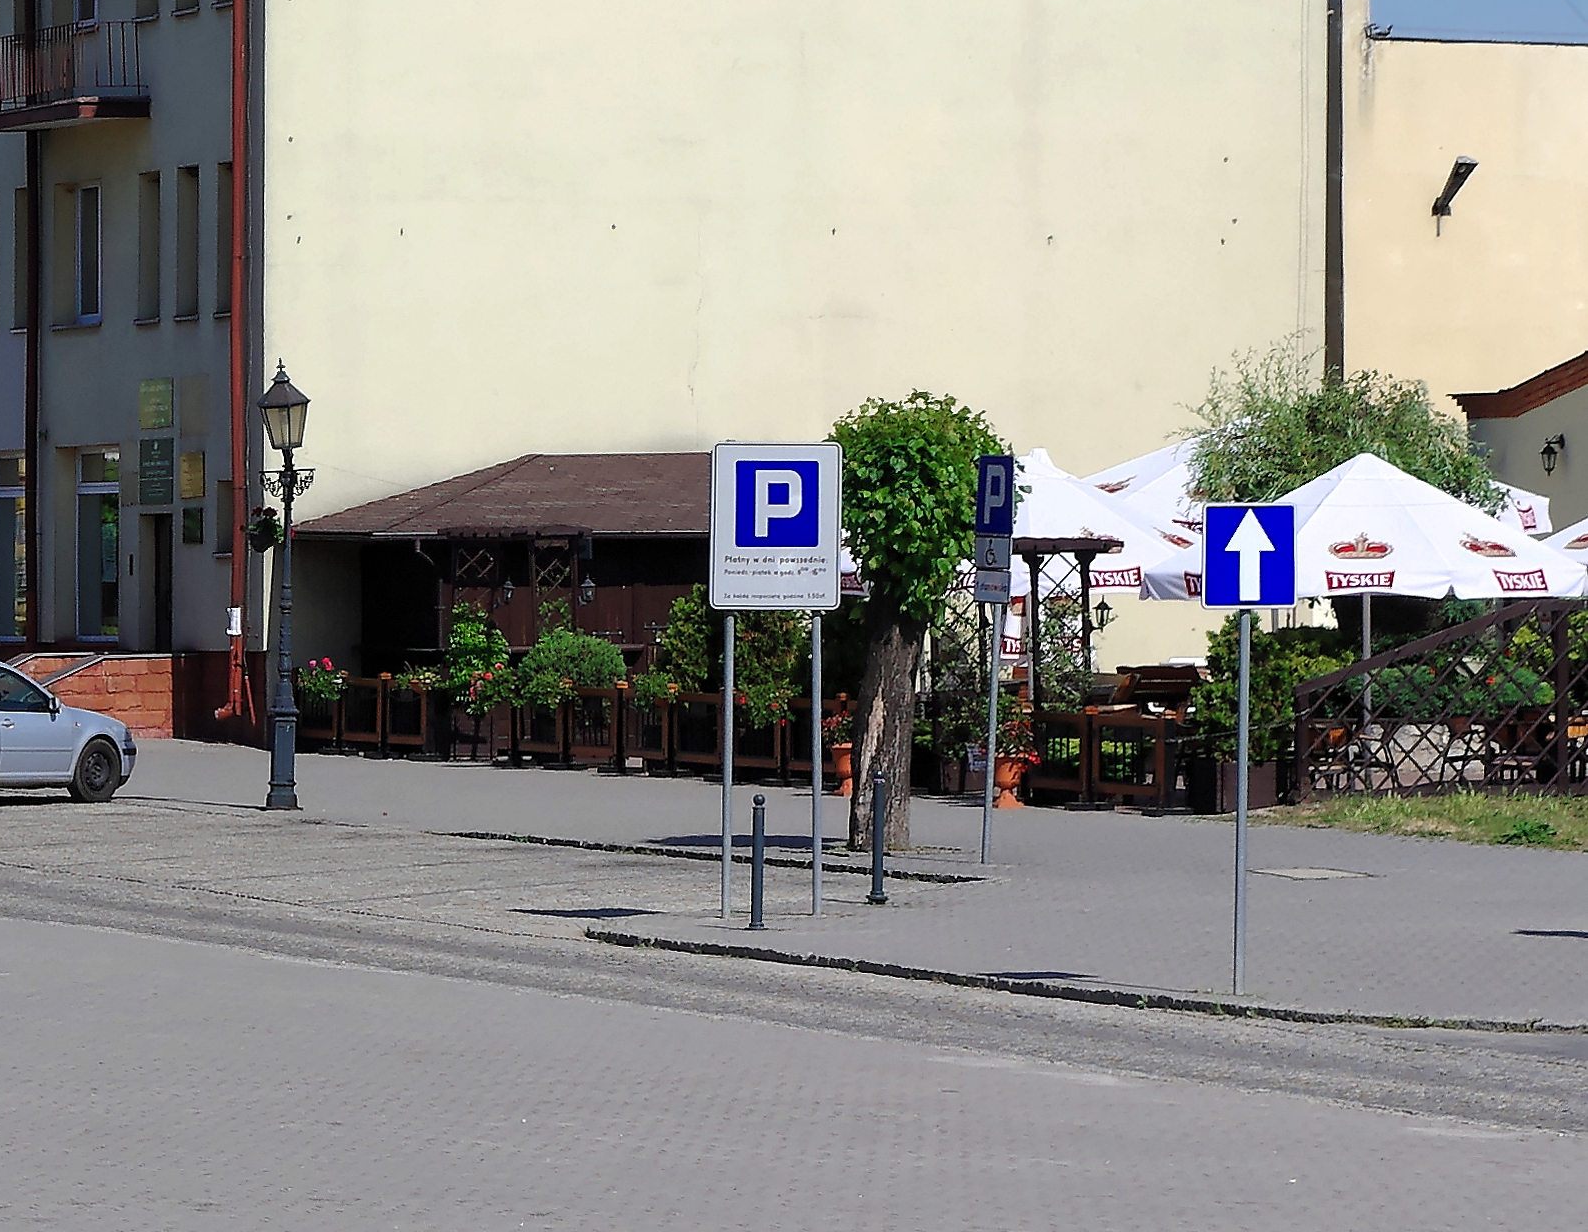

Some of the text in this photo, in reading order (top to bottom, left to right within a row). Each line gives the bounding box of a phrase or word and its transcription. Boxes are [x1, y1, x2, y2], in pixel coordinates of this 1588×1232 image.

[984, 464, 1006, 525] P
[755, 470, 803, 537] P
[763, 555, 775, 563] dni
[1089, 569, 1141, 586] TYSKIE
[1328, 573, 1391, 587] TYSKIE
[1496, 572, 1546, 589] TYSKIE
